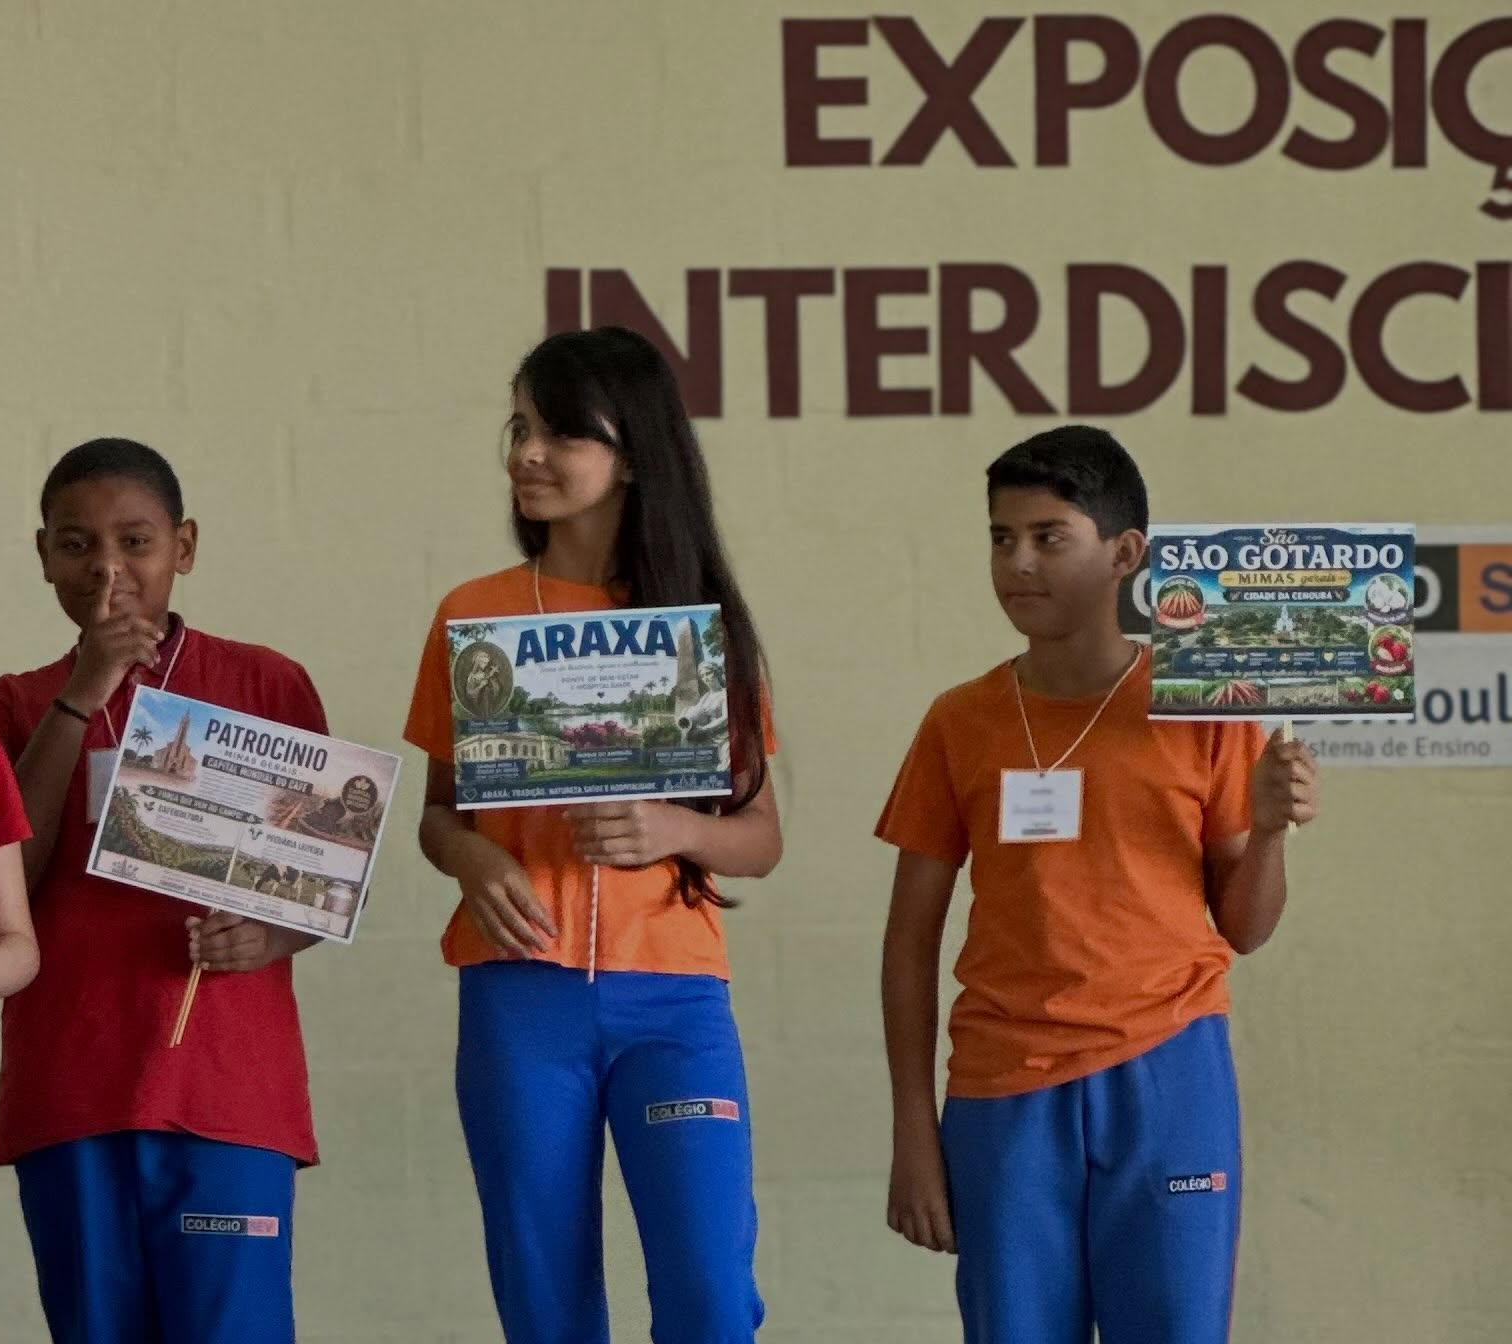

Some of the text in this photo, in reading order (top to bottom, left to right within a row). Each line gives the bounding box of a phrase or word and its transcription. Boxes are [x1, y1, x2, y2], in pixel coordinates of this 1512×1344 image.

[1160, 539, 1404, 570] SÃO GOTARDO
[1243, 590, 1333, 601] CIDADE DA CENOURA
[515, 614, 678, 667] ARAXÁ
[204, 718, 328, 772] PATROCÍNIO
[1304, 736, 1491, 757] stema de Ensino
